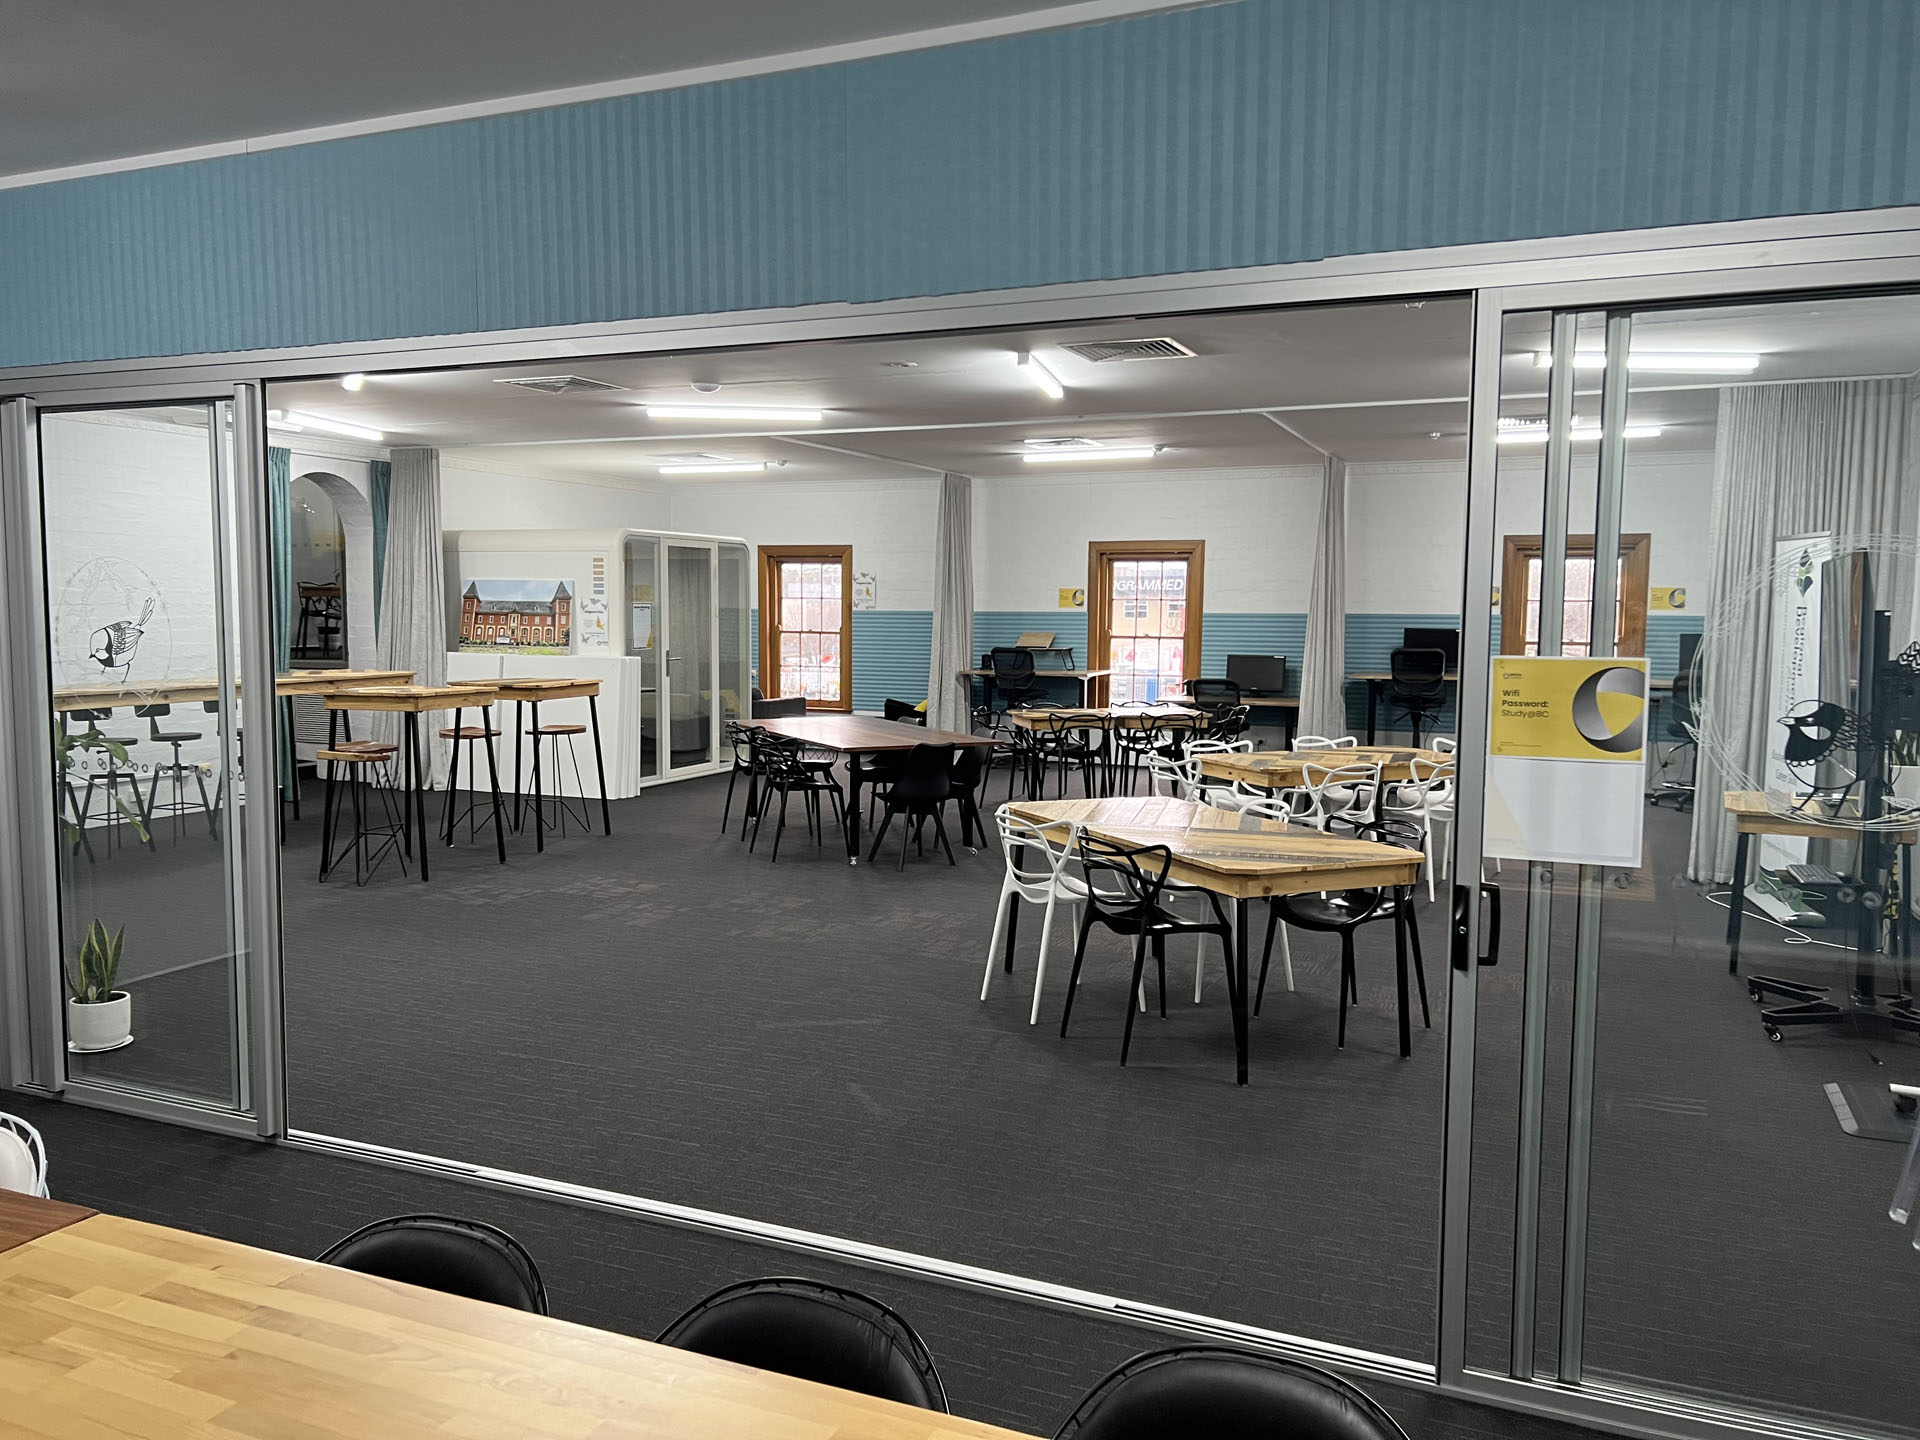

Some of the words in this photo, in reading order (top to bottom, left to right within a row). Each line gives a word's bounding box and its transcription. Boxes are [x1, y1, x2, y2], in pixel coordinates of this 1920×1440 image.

[1790, 606, 1802, 712] Development
[1797, 606, 1807, 677] Regional
[1502, 700, 1549, 708] Password:
